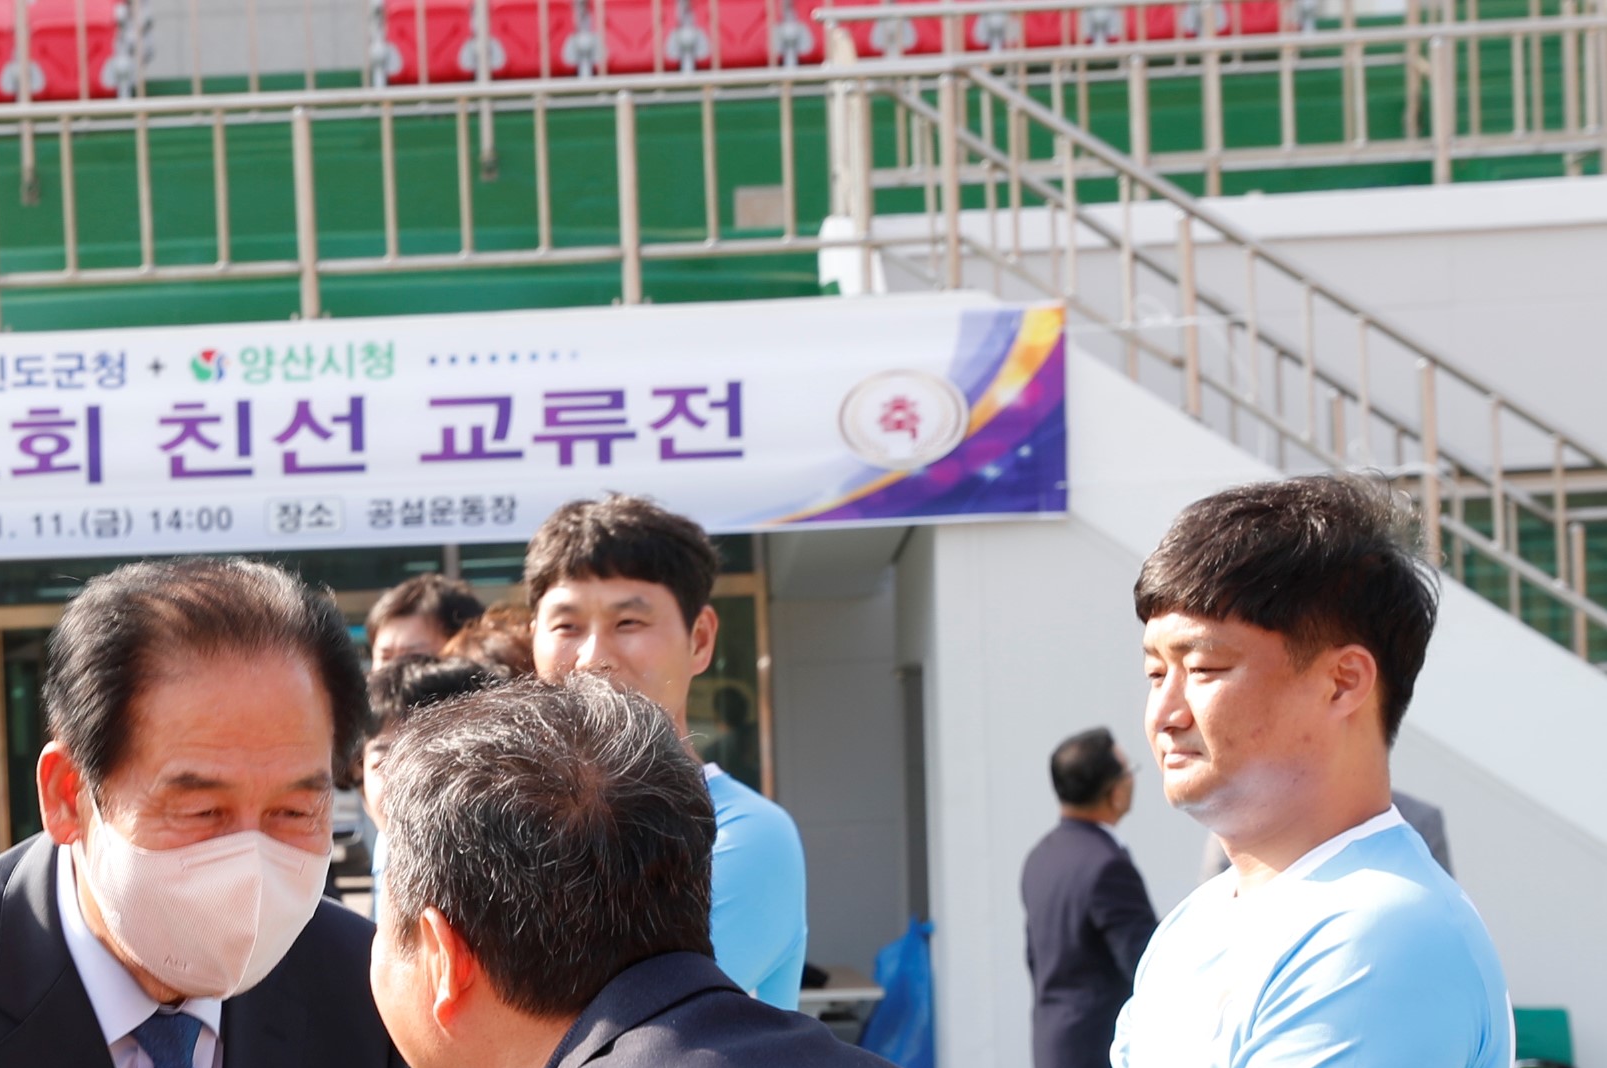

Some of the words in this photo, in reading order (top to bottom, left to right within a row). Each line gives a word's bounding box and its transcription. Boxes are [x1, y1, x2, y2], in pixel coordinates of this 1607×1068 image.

[239, 340, 395, 384] 양산시청
[158, 395, 367, 480] 친선
[420, 381, 744, 468] 교류전
[149, 506, 233, 534] 14:00
[275, 500, 335, 534] 장소
[368, 494, 518, 530] 공설운동장
